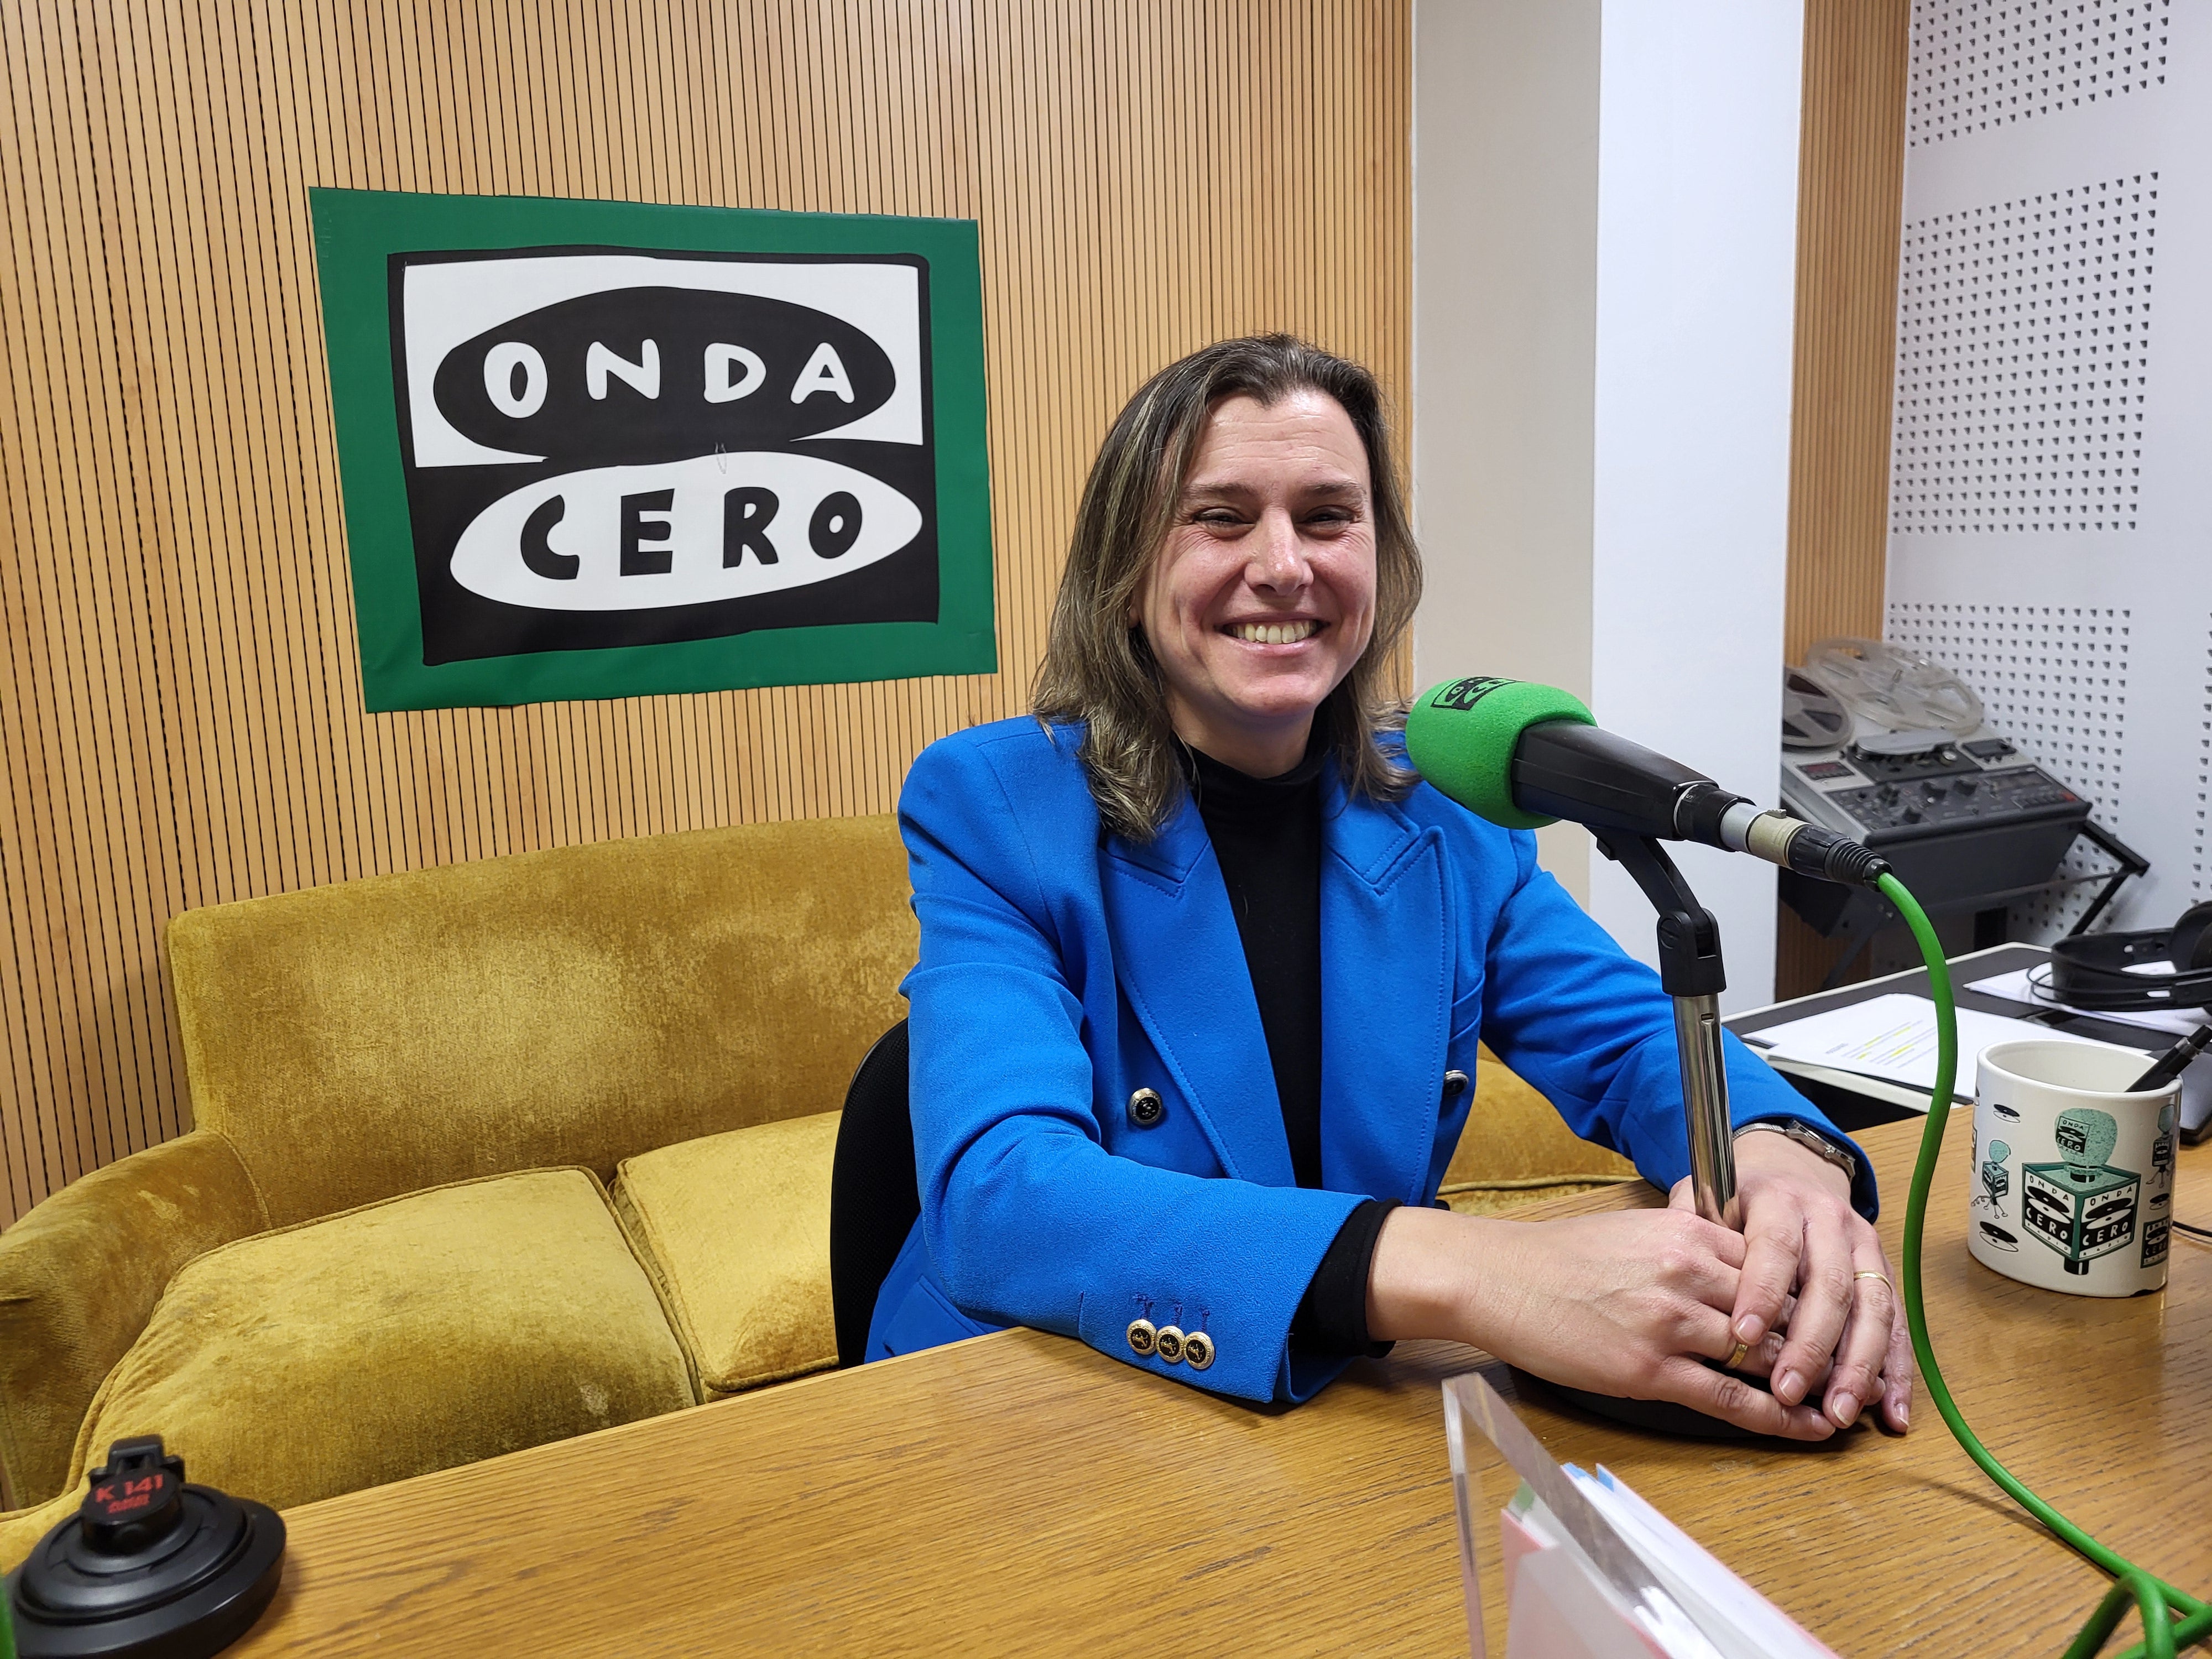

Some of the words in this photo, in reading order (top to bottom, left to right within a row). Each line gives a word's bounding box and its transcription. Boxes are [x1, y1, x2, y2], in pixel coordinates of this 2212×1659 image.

[483, 338, 855, 419] ONDA
[520, 486, 863, 581] CERO
[2062, 1119, 2084, 1130] ONDA
[2057, 1136, 2081, 1151] CERO
[2029, 1175, 2069, 1201] ONDA
[2090, 1186, 2132, 1206] ONDA
[2026, 1207, 2068, 1240] CERO
[2082, 1222, 2128, 1246] CERO
[96, 1485, 115, 1503] K
[123, 1474, 163, 1495] 141
